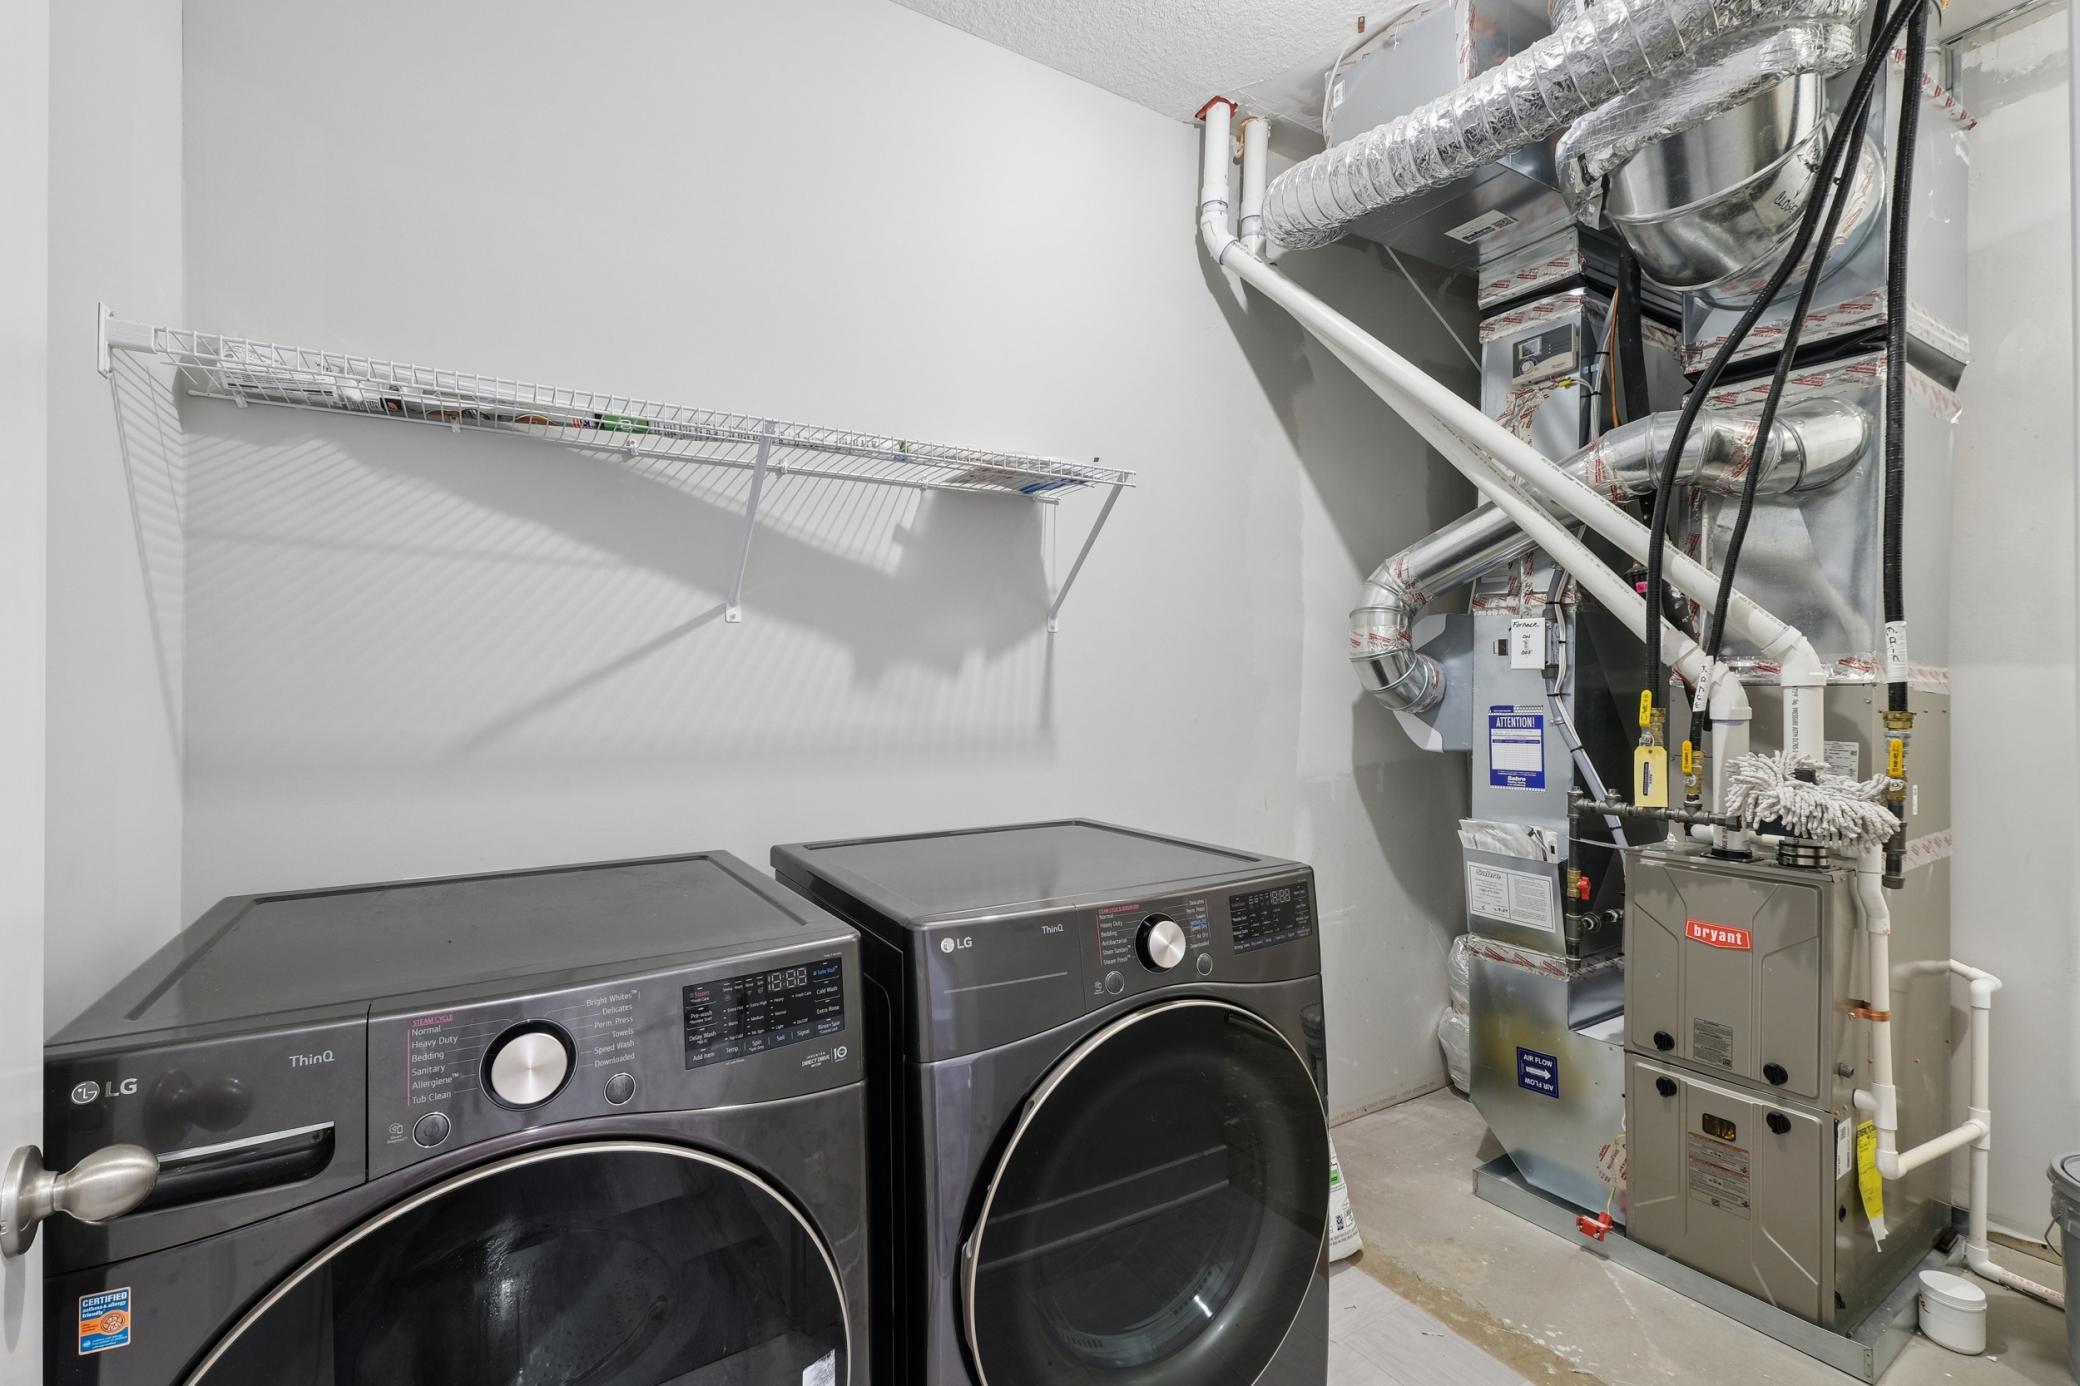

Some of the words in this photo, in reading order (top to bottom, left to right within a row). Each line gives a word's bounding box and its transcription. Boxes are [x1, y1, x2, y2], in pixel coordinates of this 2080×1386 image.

[1496, 716, 1535, 728] ATTENTION!
[1041, 923, 1064, 934] ThinQ
[1693, 924, 1743, 946] bryant
[956, 936, 973, 949] LG
[586, 996, 608, 1007] Bright
[602, 1004, 633, 1015] Delicates
[412, 1016, 434, 1028] STEAM
[615, 1017, 633, 1025] Press
[412, 1024, 441, 1036] Normal
[612, 1027, 634, 1038] Towels
[412, 1039, 436, 1049] Heavy
[438, 1035, 459, 1045] Duty
[594, 1043, 615, 1055] Speed
[616, 1039, 635, 1049] Wash
[288, 1050, 335, 1068] ThinQ
[412, 1051, 445, 1063] Bedding
[594, 1051, 635, 1068] Downloaded
[1523, 1054, 1534, 1063] AIR
[1534, 1056, 1553, 1067] FLOW
[412, 1064, 446, 1077] Sanitary
[104, 1077, 139, 1098] LG
[1524, 1077, 1542, 1088] FLOW
[1543, 1082, 1554, 1091] AIR
[412, 1095, 427, 1105] Tub
[428, 1091, 452, 1102] Clean
[82, 1291, 128, 1308] CERTIFIED
